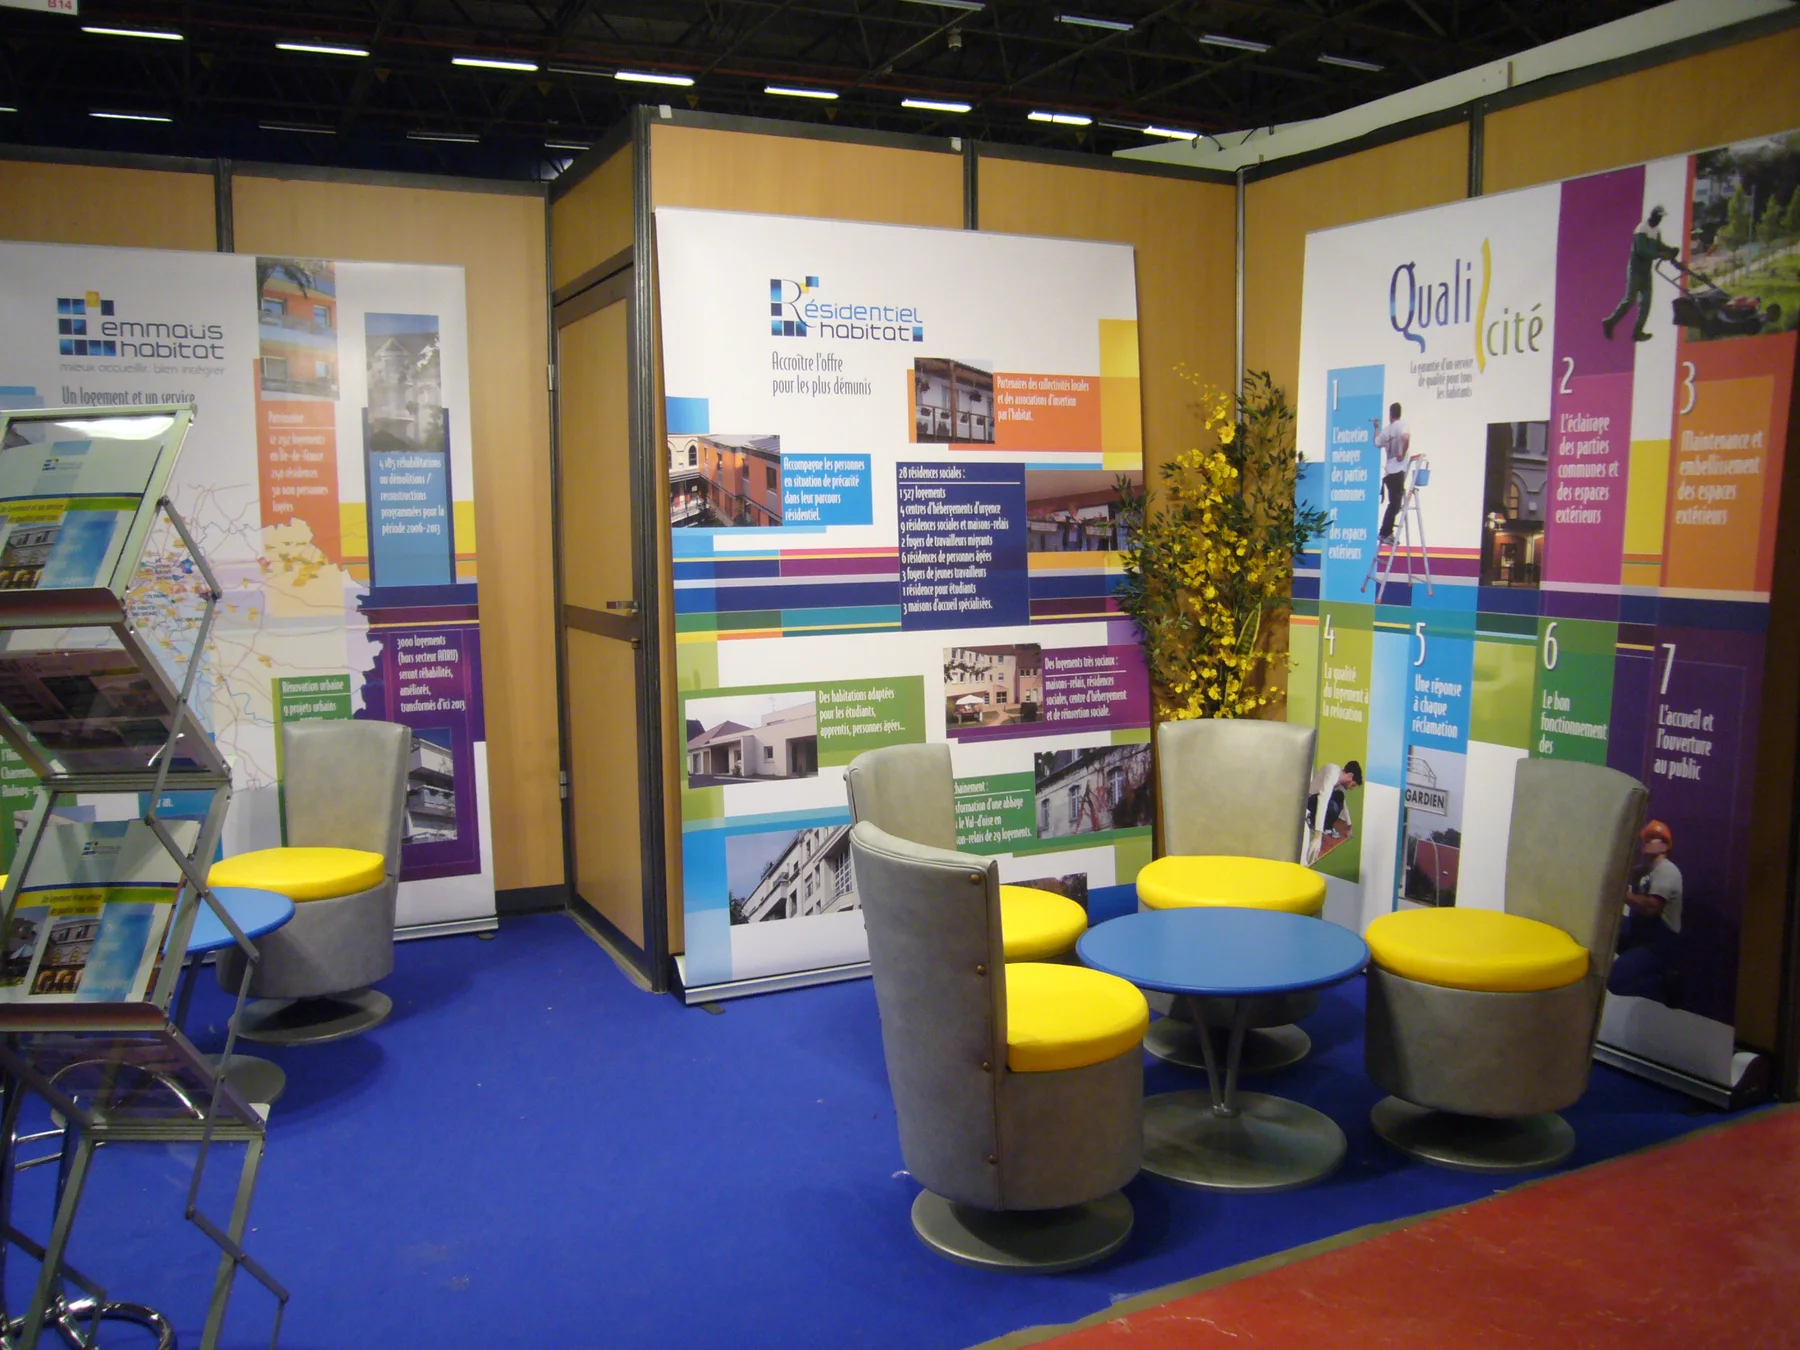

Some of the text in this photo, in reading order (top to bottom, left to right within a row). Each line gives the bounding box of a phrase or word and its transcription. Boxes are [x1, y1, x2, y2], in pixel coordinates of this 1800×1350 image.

[48, 0, 72, 10] B14
[771, 278, 923, 328] Résidentiel
[101, 321, 223, 339] emmaüs
[820, 322, 910, 342] habitat
[120, 340, 224, 359] habitat
[772, 351, 843, 372] Accroître l'offre
[997, 376, 1089, 391] Partenaires des collectivités locales
[1560, 357, 1575, 394] 2
[773, 375, 871, 397] pour les plus démunis
[1680, 362, 1696, 414] 3
[62, 386, 158, 406] Un logement et un
[1048, 394, 1077, 406] d'insertion
[1561, 413, 1610, 434] L'éclairage
[1333, 427, 1368, 443] L'entretien
[1681, 430, 1763, 451] Maintenance et
[1560, 436, 1609, 459] des parties
[397, 457, 441, 469] réhabilitations
[784, 457, 865, 473] Accompagne les personnes
[1558, 461, 1619, 478] communes et
[1679, 455, 1760, 476] embellissement
[389, 473, 425, 485] démolitions
[899, 466, 961, 479] 28 résidences sociales
[381, 490, 426, 501] reconstructions
[785, 490, 841, 506] dans leur parcours
[915, 486, 945, 500] logements
[1331, 487, 1365, 501] communes
[1557, 483, 1609, 504] des espaces
[1677, 481, 1736, 504] des espaces
[438, 504, 444, 516] la
[785, 507, 820, 521] résidentiel.
[900, 501, 1001, 517] 4 centres d'hébergements d'urgence
[1556, 505, 1601, 524] extérieurs
[1676, 505, 1727, 525] extérieurs
[382, 522, 441, 536] période 2006-2013
[1329, 526, 1366, 542] des espaces
[968, 535, 993, 548] migrants
[907, 550, 975, 565] résidences de personnes
[1328, 544, 1361, 559] extérieurs
[907, 565, 986, 582] foyers de jeunes travailleurs
[907, 581, 976, 597] résidence pour étudiants
[908, 597, 957, 612] maisons d'accueil
[397, 635, 445, 649] 3000 logements
[1324, 614, 1335, 656] 4
[1414, 622, 1426, 666] 5
[1543, 622, 1558, 670] 6
[398, 649, 458, 666] (hors secteur ANRU)
[1045, 655, 1115, 671] Des logements très sociaux
[399, 666, 453, 680] seront réhabilités,
[1325, 663, 1357, 682] La qualité
[1660, 644, 1676, 694] 7
[282, 679, 344, 692] Rénovation urbaine
[1415, 674, 1462, 697] Une réponse
[819, 687, 894, 703] Des habitations adaptées
[1046, 690, 1127, 705] sociales, centre d'hébergement
[1333, 685, 1363, 704] logement
[1542, 689, 1570, 712] Le bon
[313, 700, 337, 712] urbains
[401, 698, 451, 713] transformés d'ici
[820, 705, 876, 723] pour les étudiants,
[1330, 705, 1363, 723] relocation
[1420, 699, 1447, 716] chaque
[1541, 712, 1607, 741] fonctionnement
[1659, 704, 1714, 732] L'accueil et
[820, 722, 882, 739] apprentis, personnes
[1412, 718, 1458, 738] réclamation
[1539, 733, 1553, 754] des
[1657, 728, 1712, 756] l'ouverture
[1654, 758, 1700, 781] au public
[987, 798, 1002, 810] d'une
[1003, 796, 1023, 809] abbaye
[1405, 788, 1445, 809] GARDIEN
[985, 828, 1032, 843] de 29 logements.
